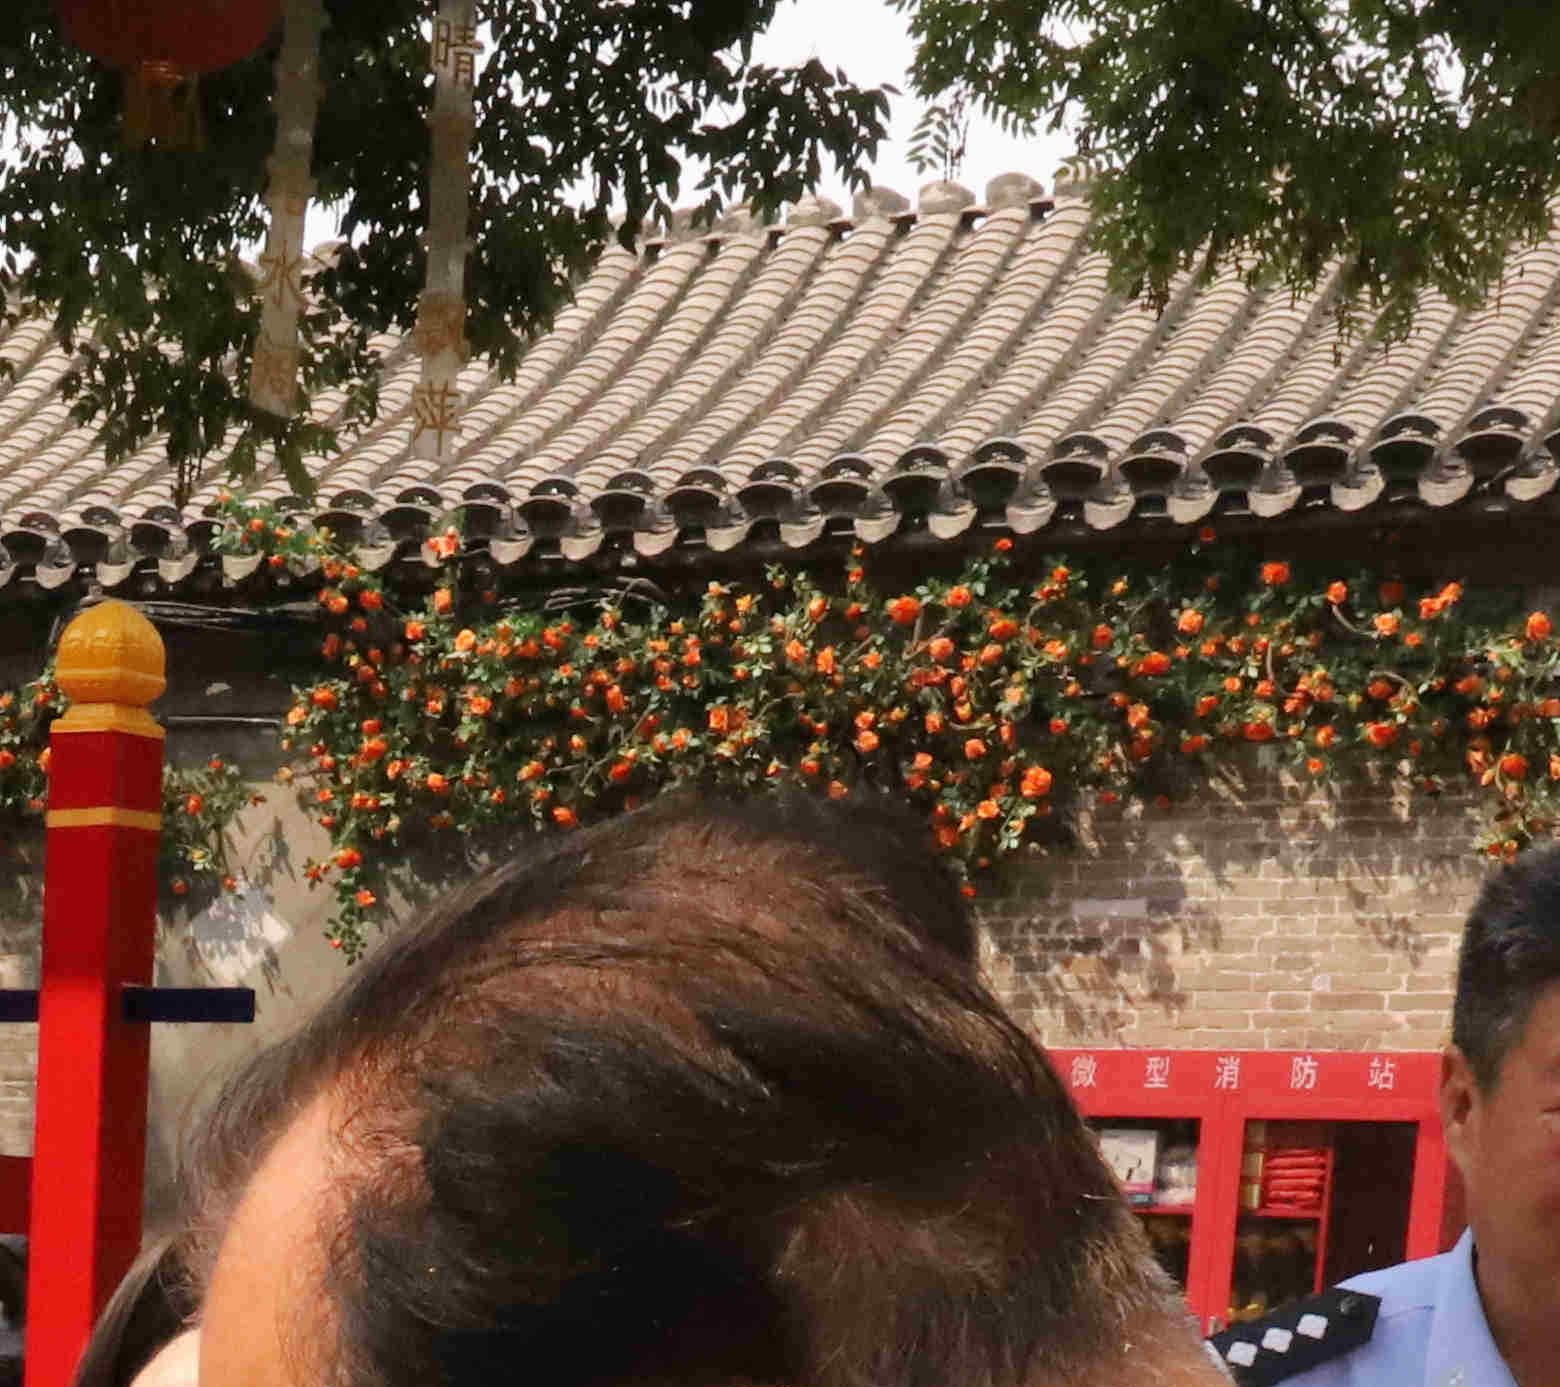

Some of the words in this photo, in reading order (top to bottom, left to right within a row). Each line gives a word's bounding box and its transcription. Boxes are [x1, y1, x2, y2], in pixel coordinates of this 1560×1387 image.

[1070, 1054, 1398, 1091] 微型消防站
